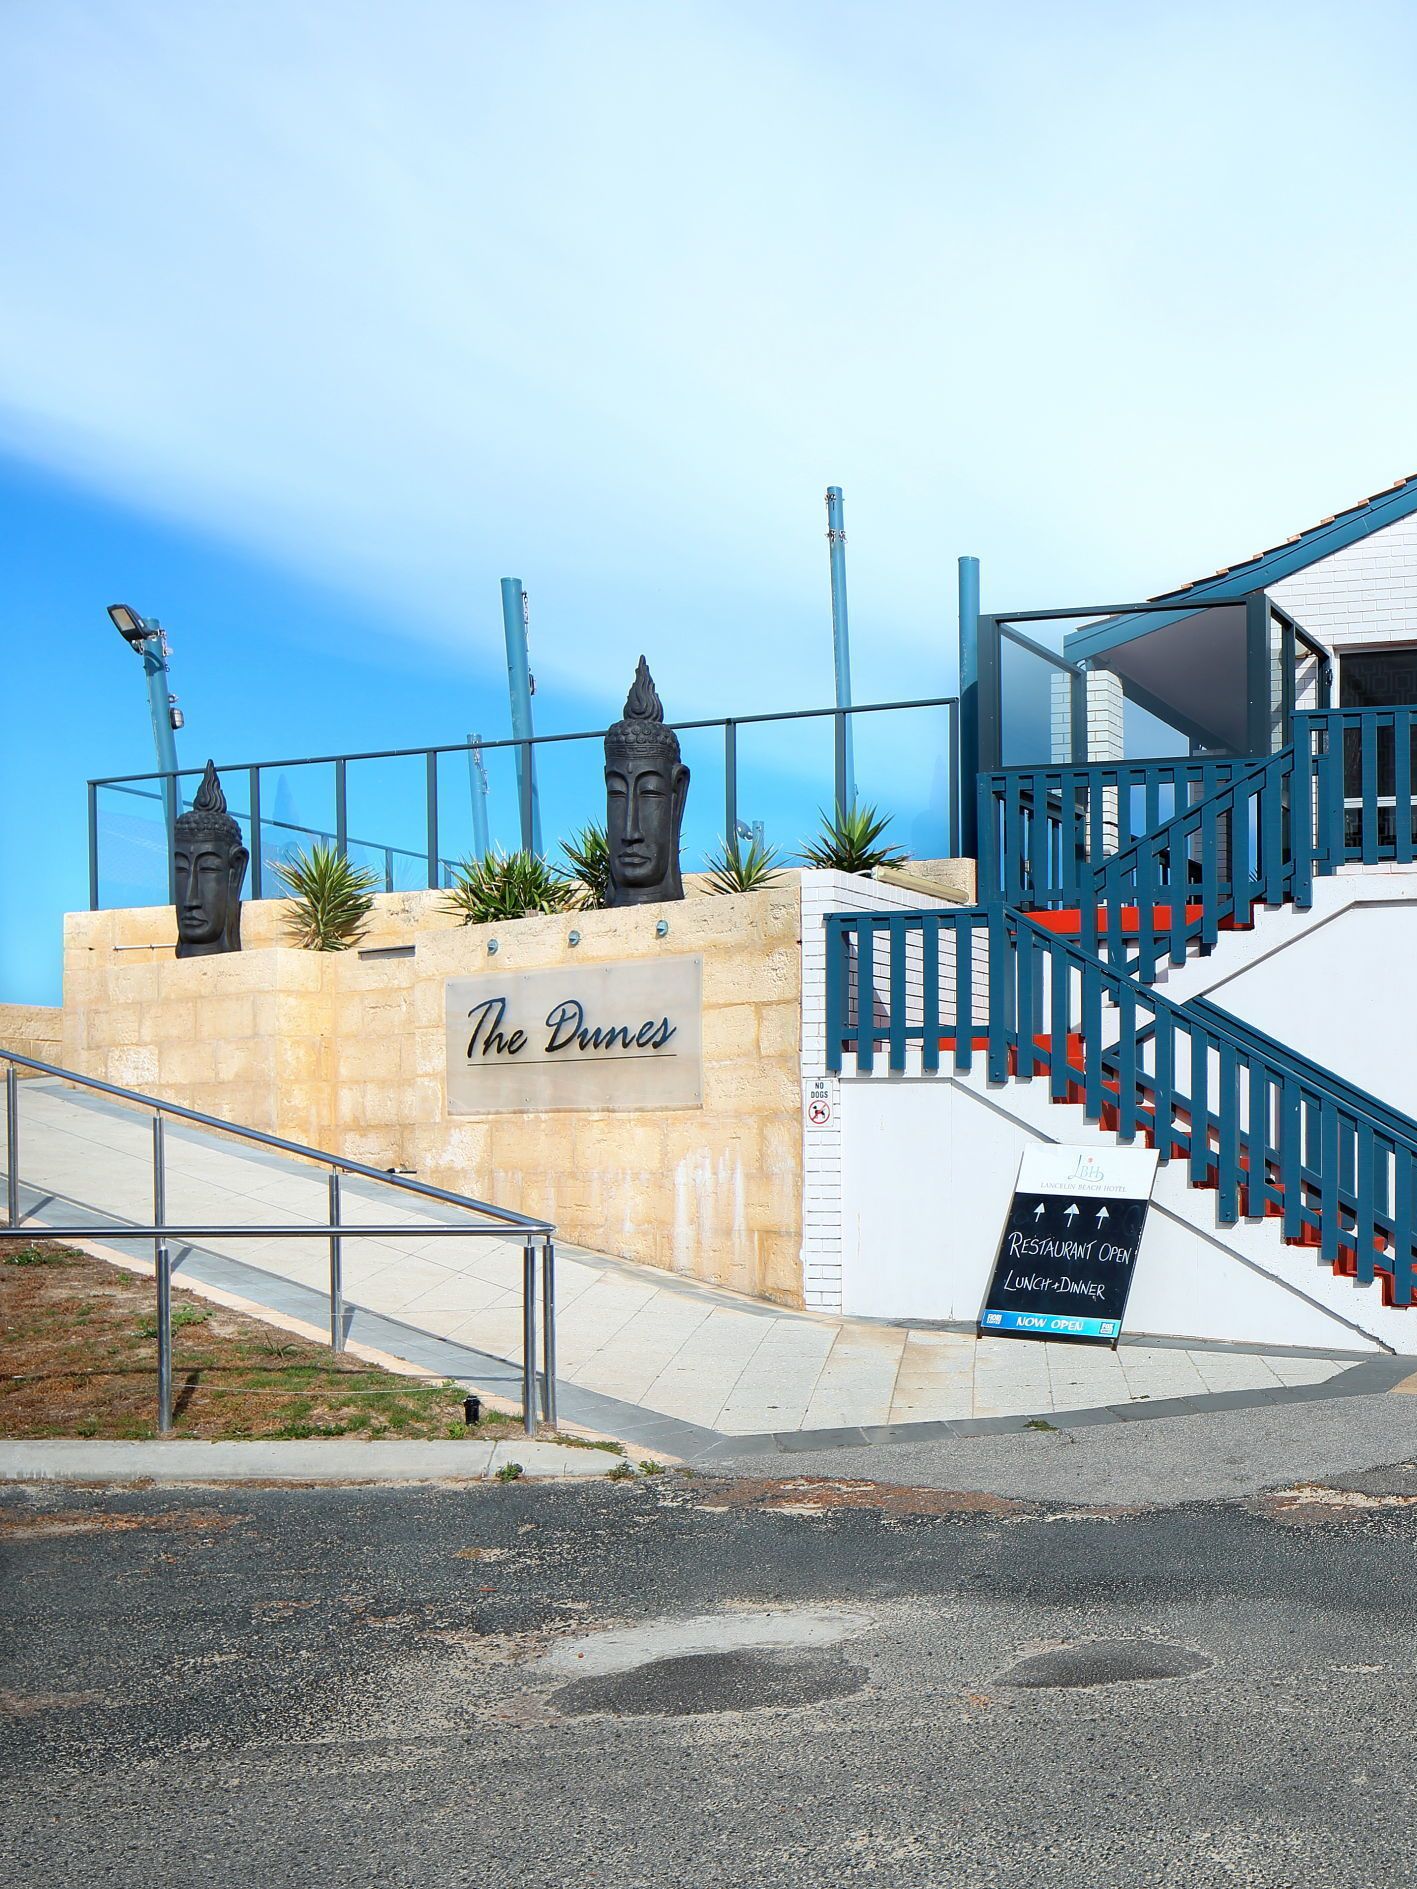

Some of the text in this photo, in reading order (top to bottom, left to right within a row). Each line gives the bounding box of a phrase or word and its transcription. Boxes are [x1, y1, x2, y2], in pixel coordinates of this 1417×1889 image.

[467, 996, 677, 1059] The Dunes
[815, 1082, 824, 1090] NO
[810, 1091, 829, 1099] DOGS
[1040, 1182, 1076, 1190] LANCELIN
[1104, 1185, 1127, 1193] HOTEL
[1008, 1231, 1132, 1264] RESTAURANT OPEN
[1016, 1316, 1047, 1328] NOW
[1051, 1319, 1083, 1330] OPEN
